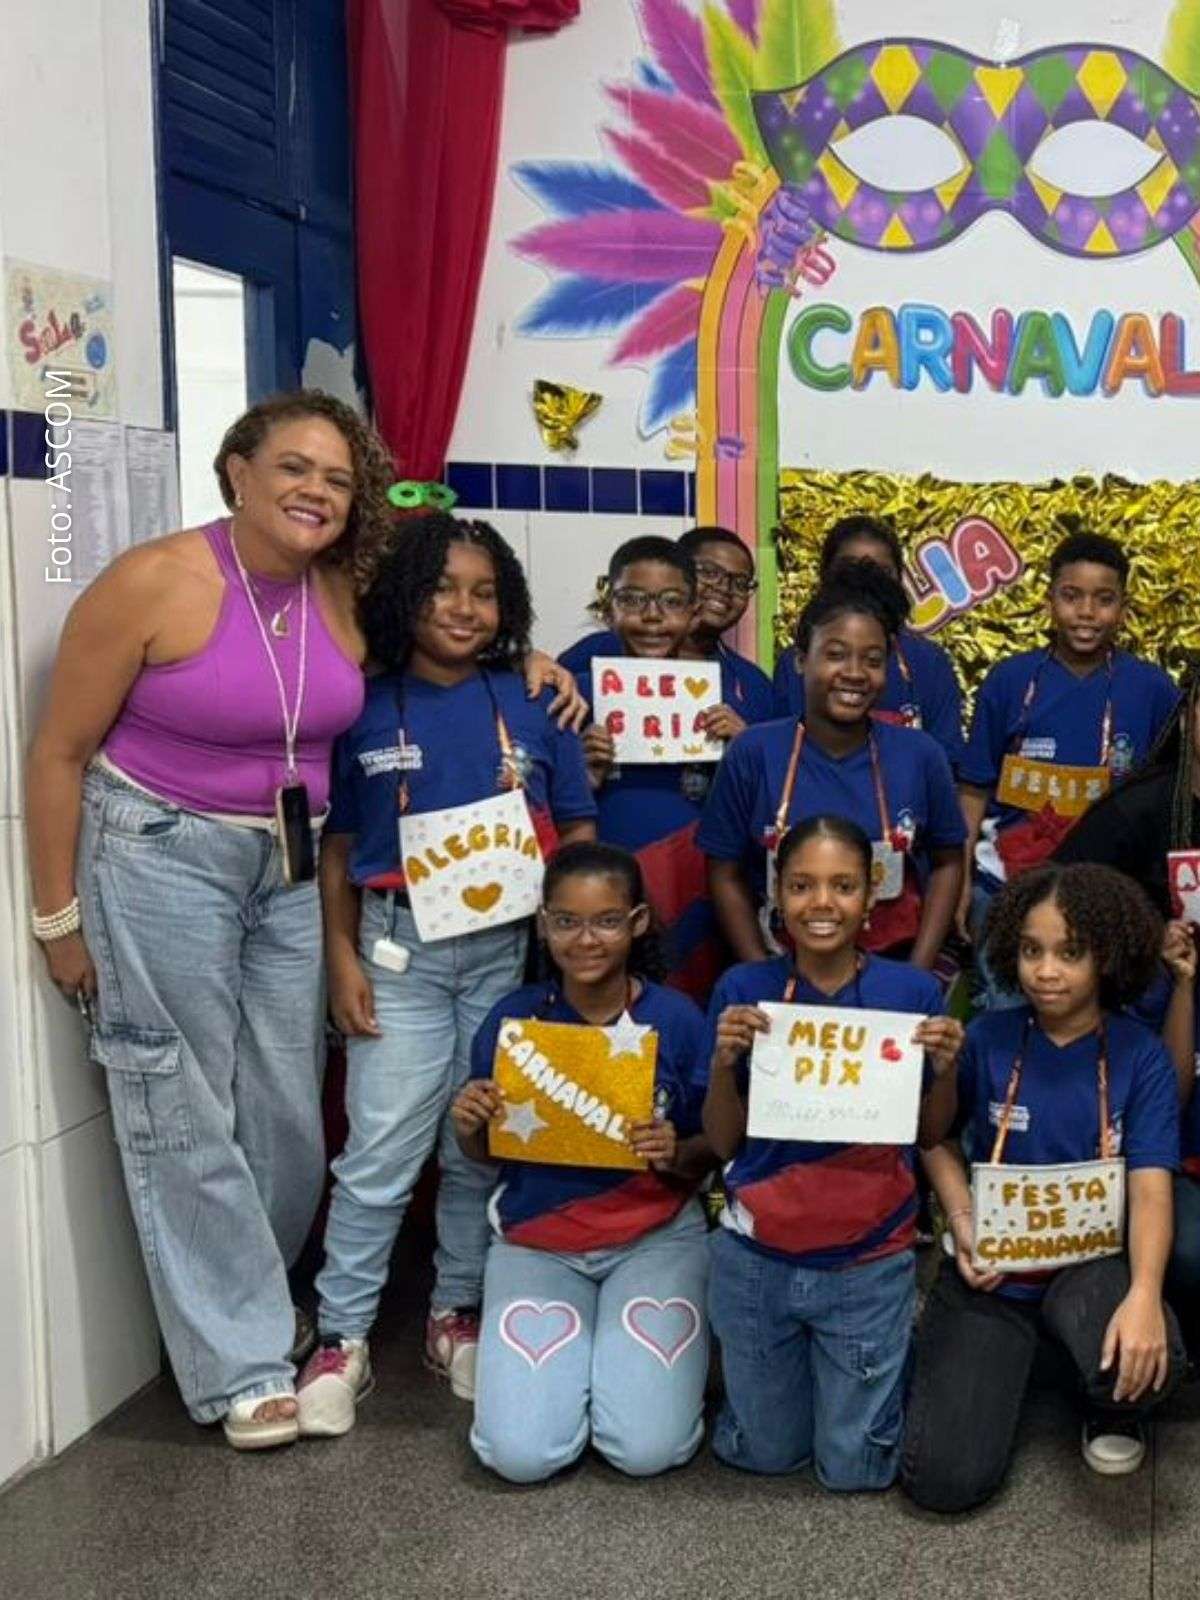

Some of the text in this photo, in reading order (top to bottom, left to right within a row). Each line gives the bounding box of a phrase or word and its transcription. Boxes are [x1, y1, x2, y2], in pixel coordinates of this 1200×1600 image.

[600, 667, 677, 698] ALE
[405, 823, 539, 885] ALEGRIA
[787, 1019, 867, 1052] MEU
[499, 1020, 625, 1142] CARNAVAL
[1001, 1177, 1106, 1208] FESTA
[1027, 1206, 1067, 1232] DE
